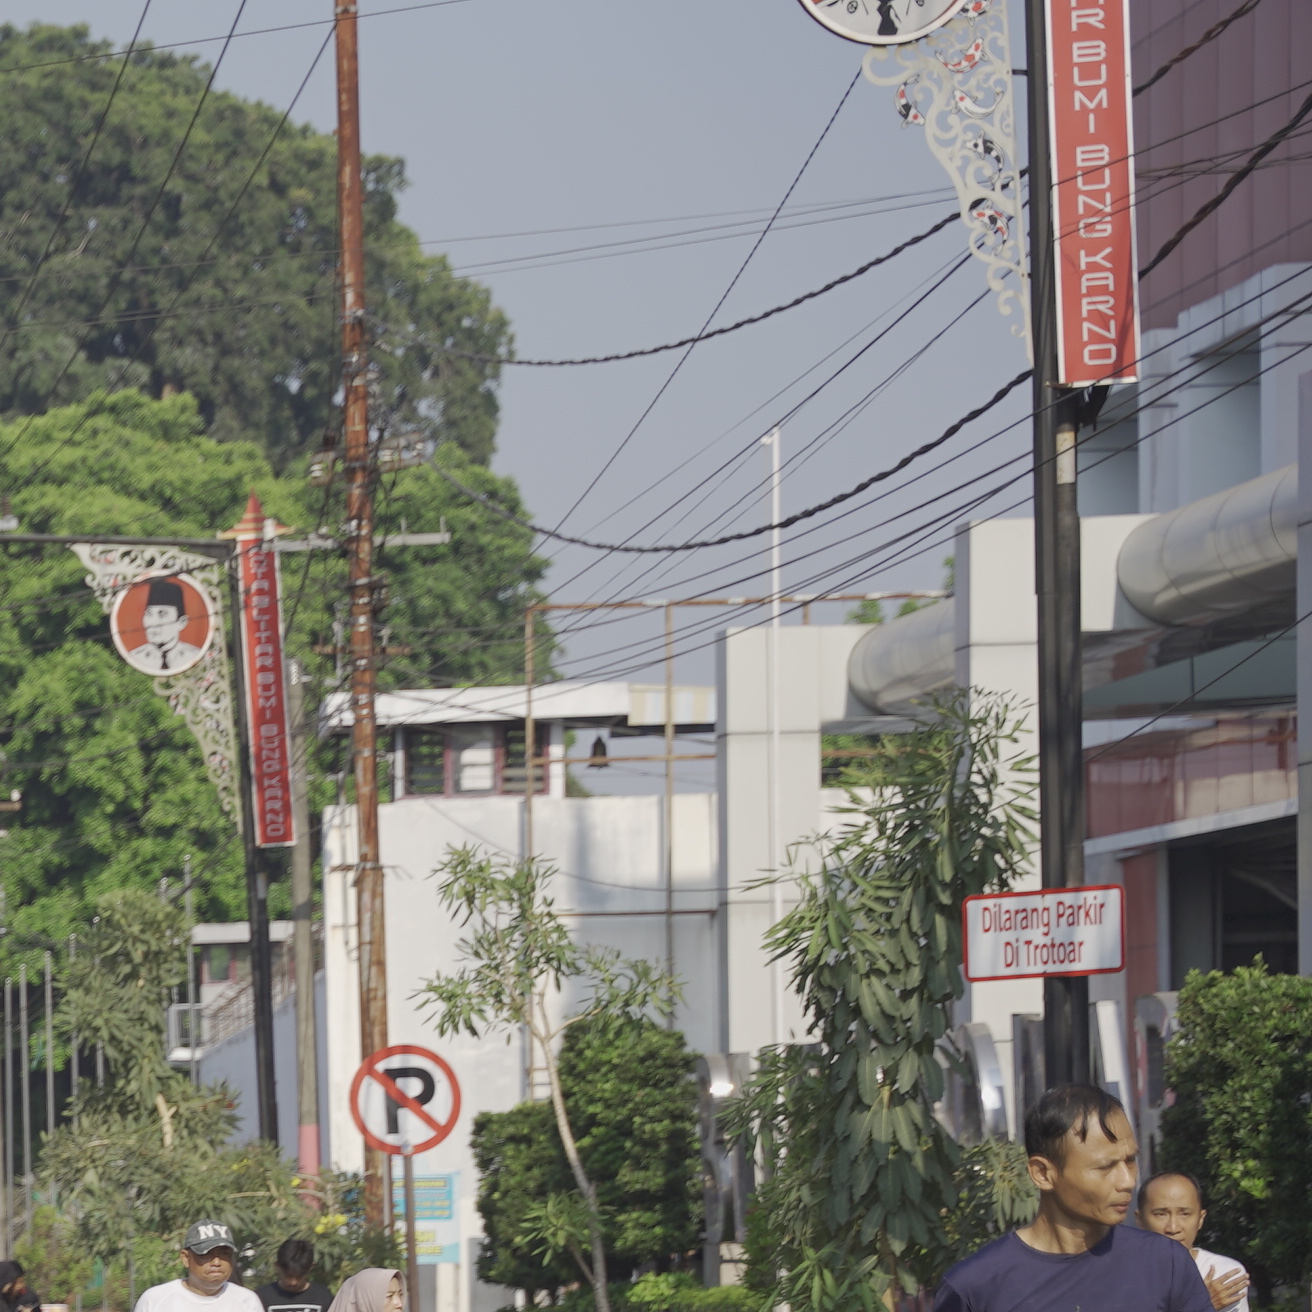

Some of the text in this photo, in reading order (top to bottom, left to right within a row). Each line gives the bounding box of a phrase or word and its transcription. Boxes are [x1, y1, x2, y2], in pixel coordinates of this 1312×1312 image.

[1072, 40, 1108, 134] BUMI
[1076, 145, 1113, 239] BUNG
[1079, 247, 1117, 366] KARNO
[982, 896, 1105, 936] Dilarang Parkir
[1004, 937, 1084, 968] Di Trotoar
[384, 1067, 435, 1134] P
[198, 1224, 228, 1239] NY
